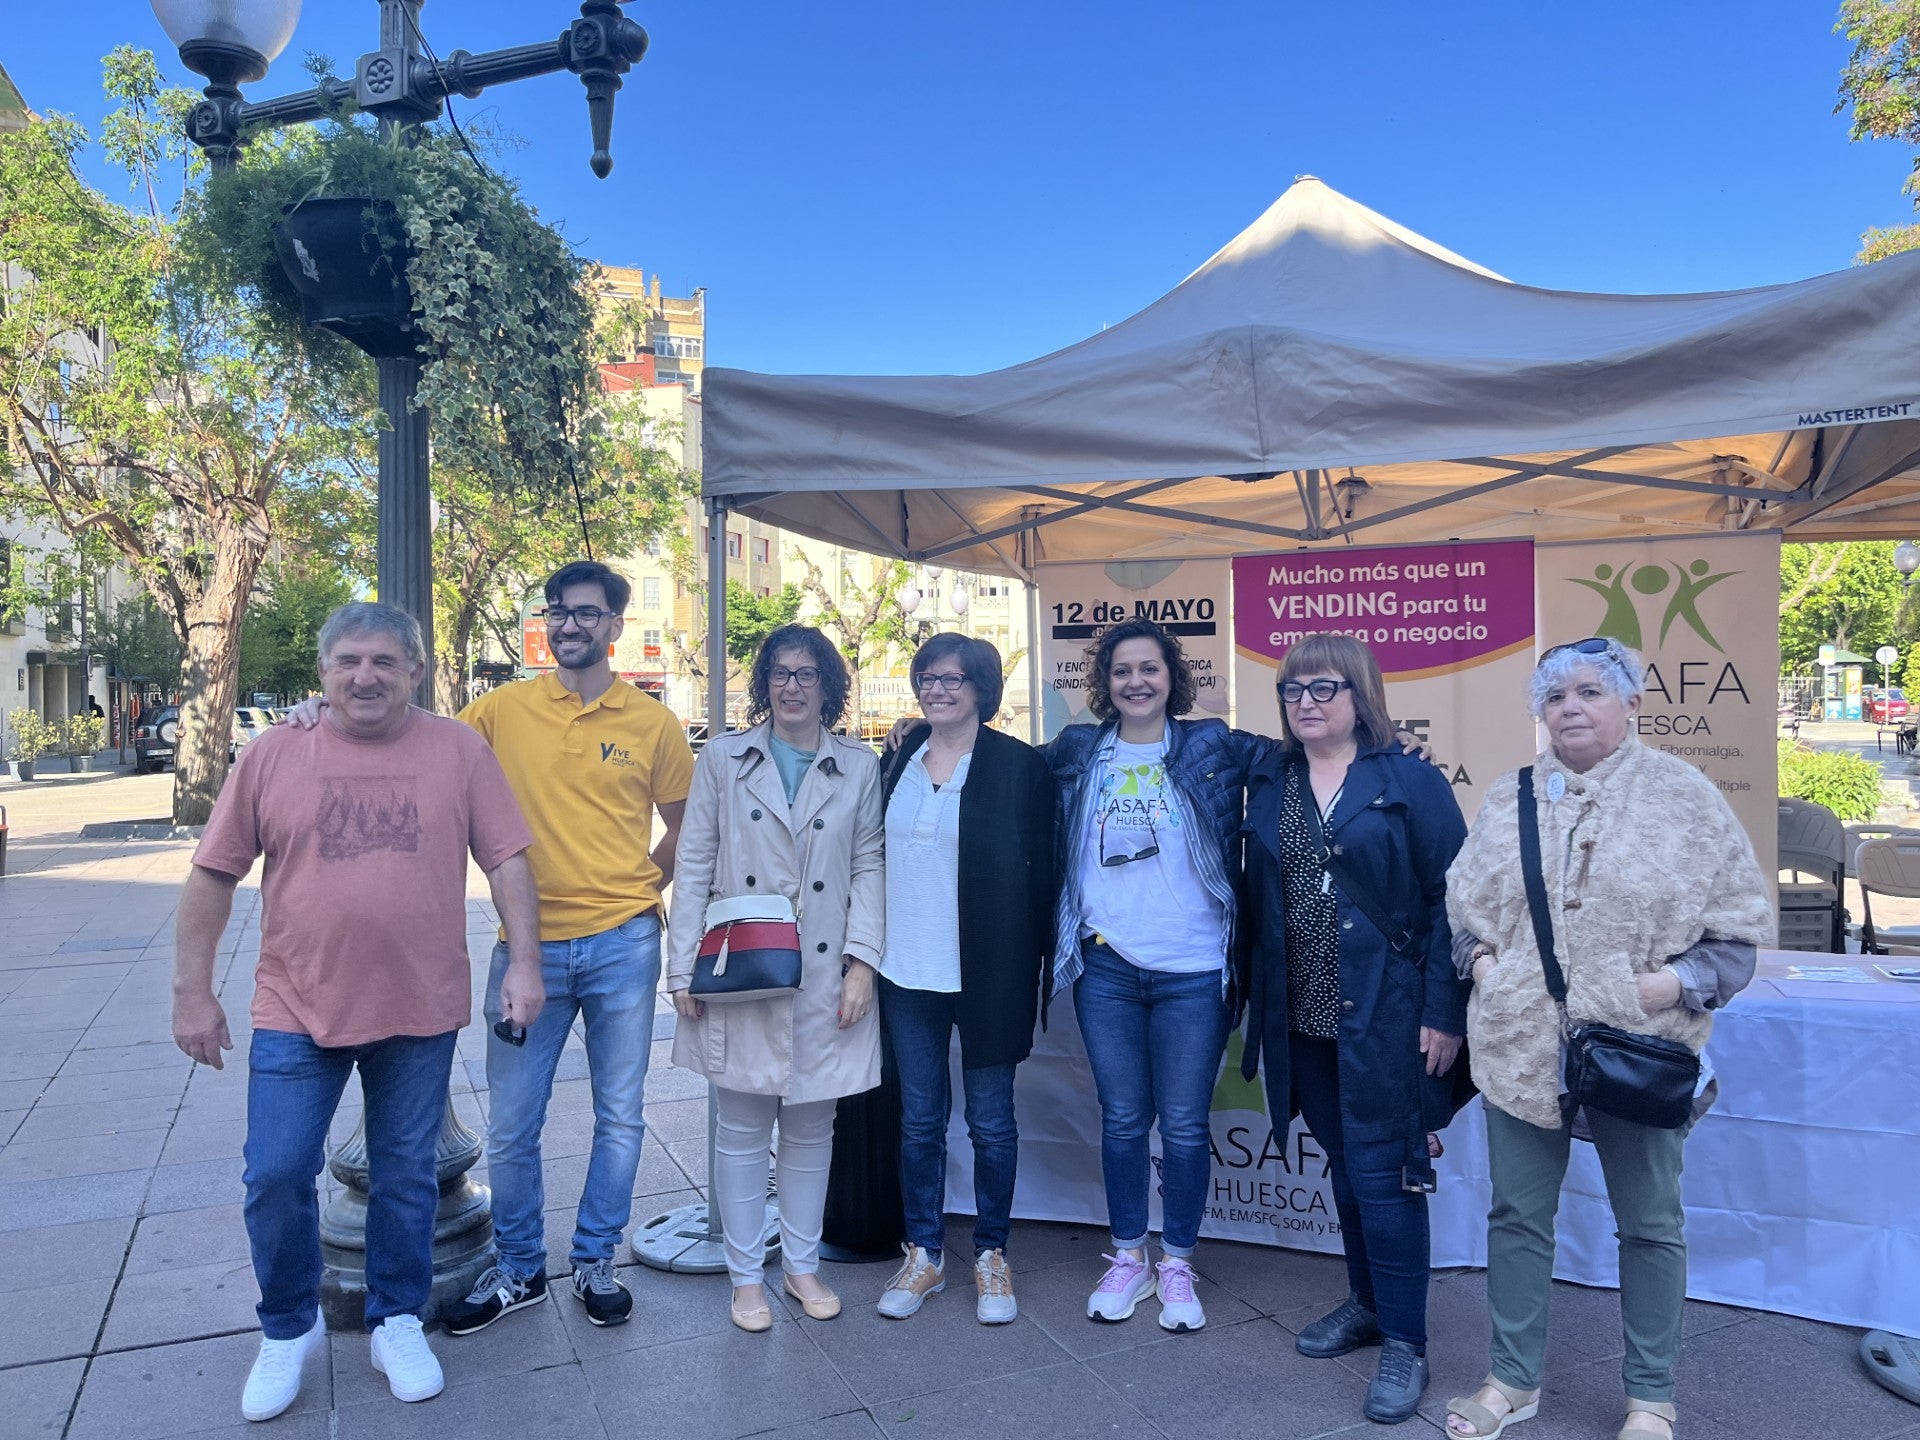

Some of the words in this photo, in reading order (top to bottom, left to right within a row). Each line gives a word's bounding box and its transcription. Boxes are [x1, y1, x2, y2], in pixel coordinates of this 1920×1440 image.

[1798, 403, 1911, 426] MASTERTENT
[1268, 565, 1344, 586] Mucho
[1349, 562, 1399, 582] más
[1404, 562, 1450, 583] que
[1455, 561, 1486, 577] un
[1052, 603, 1084, 624] 12
[1093, 602, 1125, 623] de
[1135, 598, 1215, 621] MAYO
[1268, 591, 1398, 620] VENDING
[1403, 598, 1459, 618] para
[1464, 594, 1487, 612] tu
[1374, 628, 1389, 643] o
[1394, 621, 1488, 645] negocio
[1108, 798, 1169, 814] ASAFA
[1214, 1177, 1328, 1215] HUESCA
[1203, 1206, 1226, 1221] FM,
[1229, 1208, 1280, 1228] EM/SFC,
[1283, 1218, 1314, 1232] SQM
[1317, 1223, 1325, 1235] y
